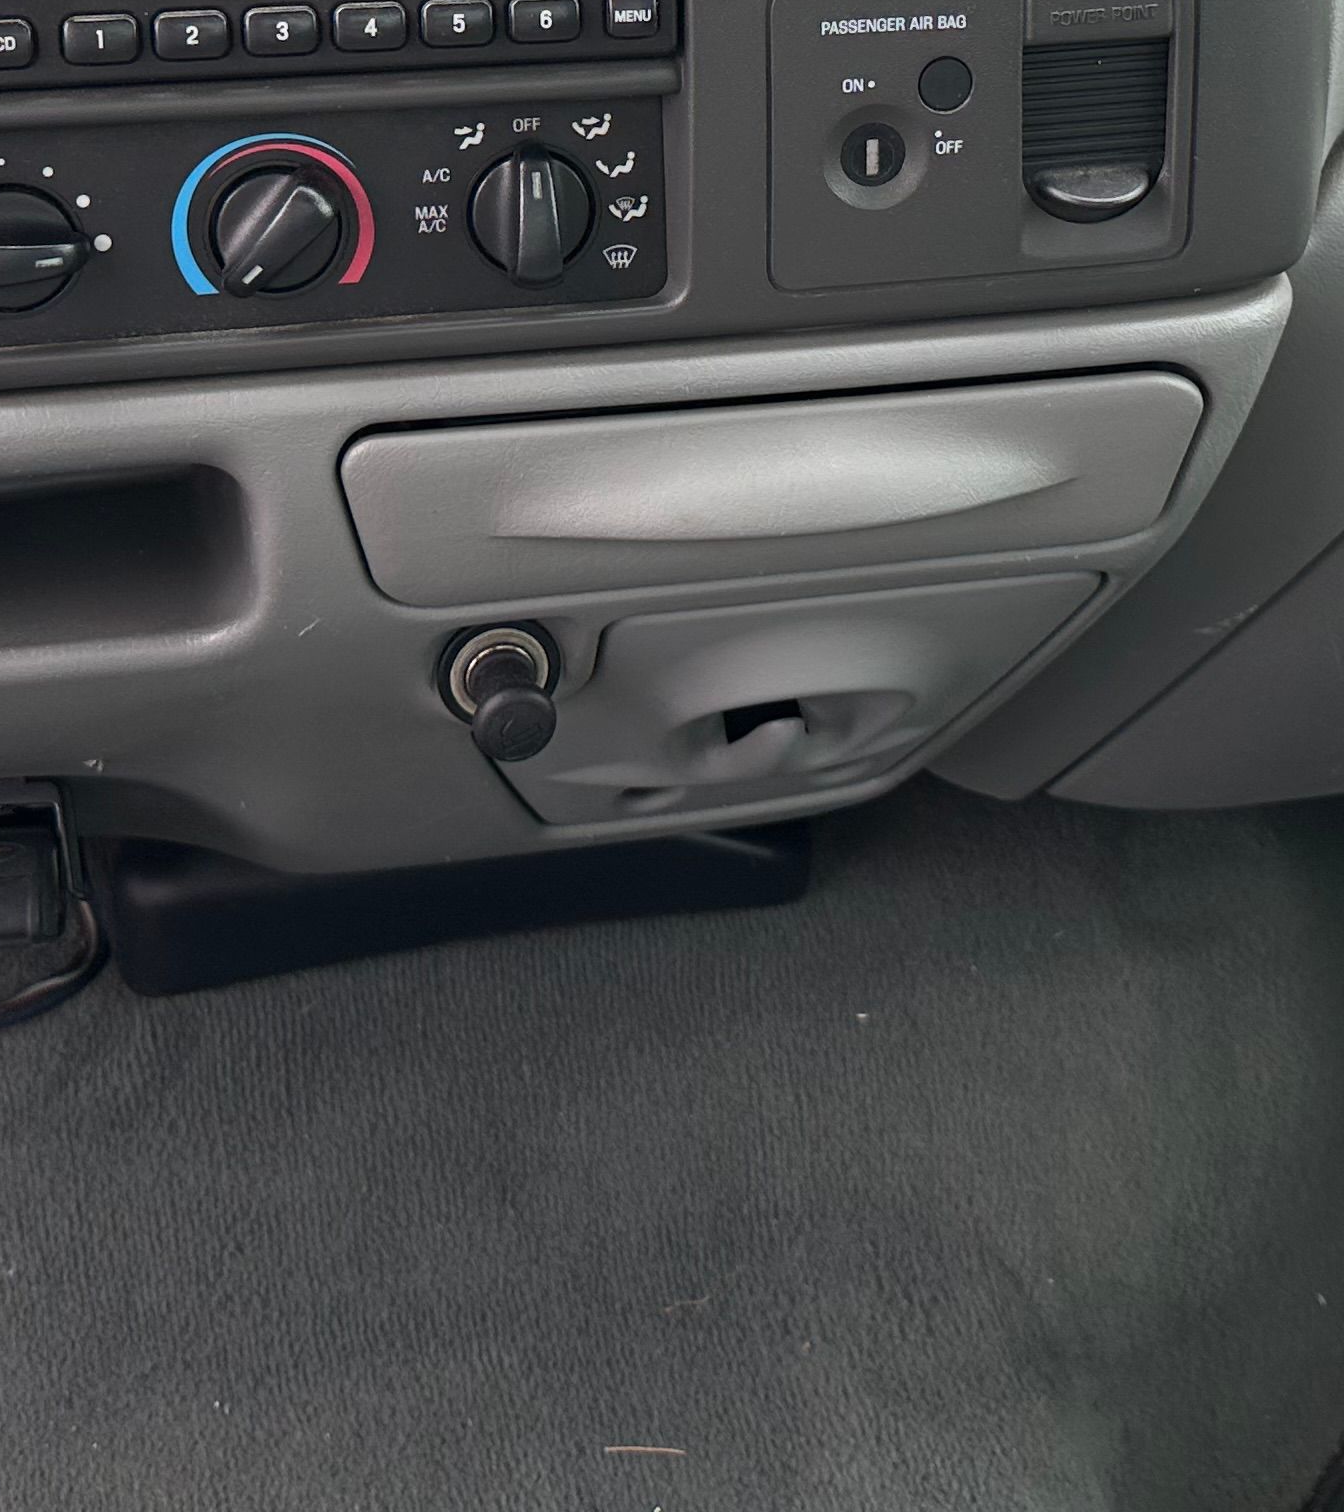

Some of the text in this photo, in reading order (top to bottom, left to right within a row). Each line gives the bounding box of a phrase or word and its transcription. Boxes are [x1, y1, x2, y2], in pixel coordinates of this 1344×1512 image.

[453, 14, 465, 33] 5
[539, 10, 552, 29] 6
[615, 8, 651, 23] MENU
[276, 21, 289, 41] 3
[364, 18, 377, 37] 4
[821, 15, 967, 36] PASSENGER AIR BAG
[95, 30, 105, 48] 1
[186, 27, 198, 45] 2
[842, 78, 864, 93] ON
[512, 117, 541, 134] OFF
[935, 140, 963, 155] OFF
[422, 166, 451, 184] A/C
[415, 204, 449, 220] MAX
[418, 219, 447, 233] A/C
